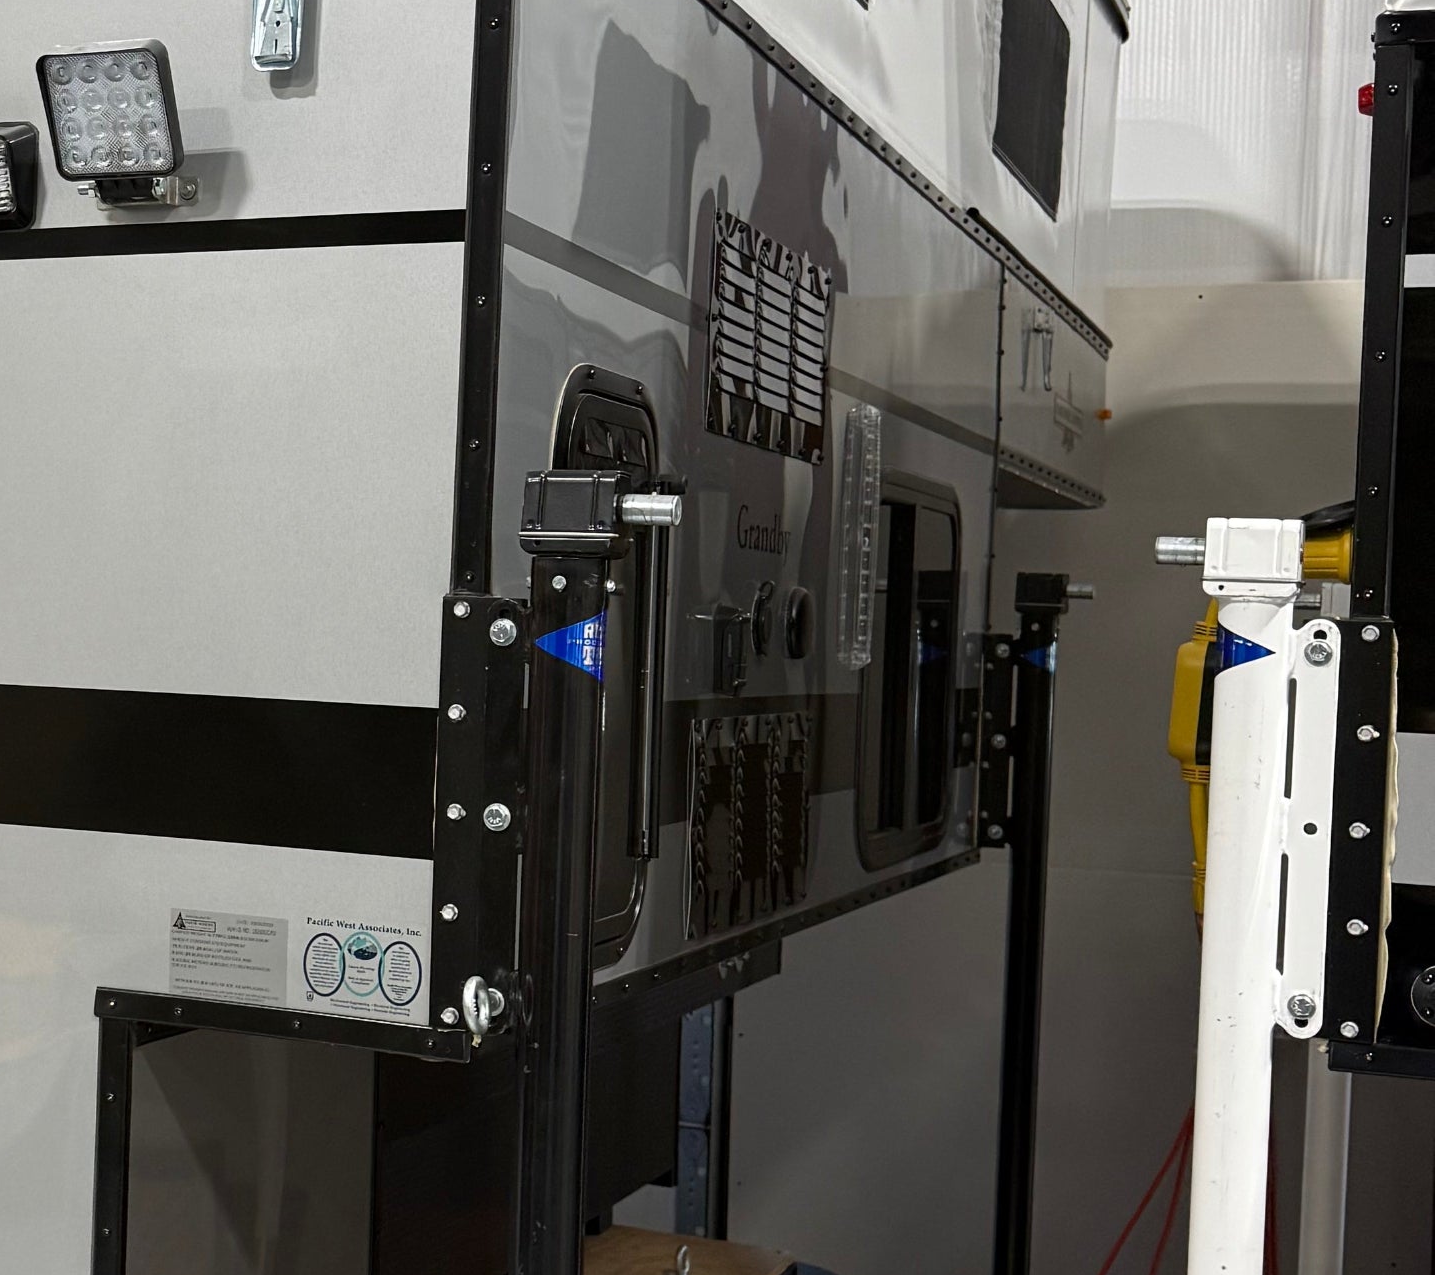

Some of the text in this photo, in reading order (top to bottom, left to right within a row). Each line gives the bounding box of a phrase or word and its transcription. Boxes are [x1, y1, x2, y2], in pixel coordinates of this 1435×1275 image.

[737, 504, 791, 566] Grandby
[306, 917, 422, 937] Pacific West Associates, Inc.
